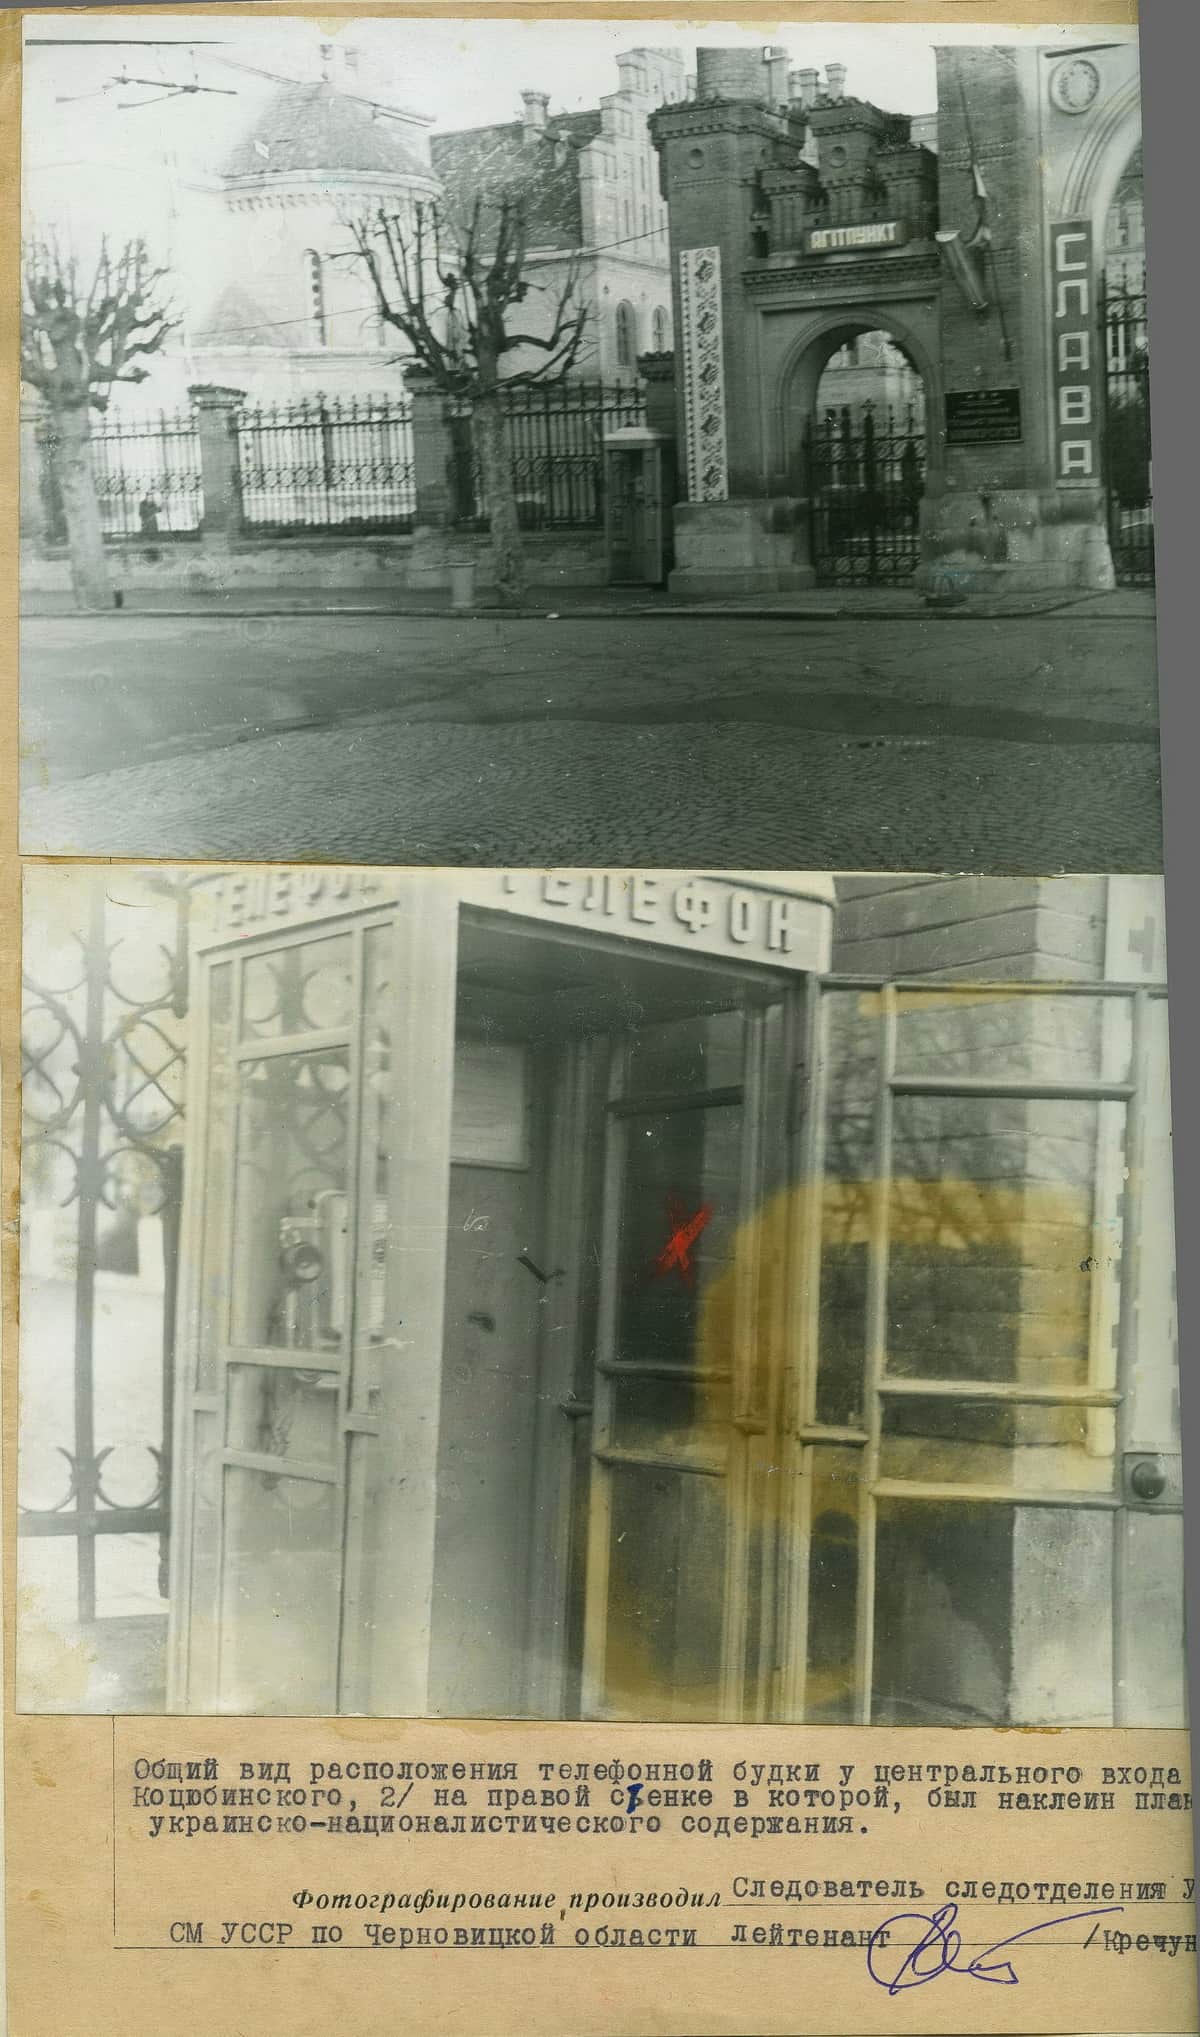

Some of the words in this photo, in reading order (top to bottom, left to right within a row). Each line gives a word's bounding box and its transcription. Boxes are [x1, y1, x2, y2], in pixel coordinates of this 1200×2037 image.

[1055, 232, 1093, 475] СЛАВА
[134, 1758, 219, 1785] Общий
[240, 1763, 291, 1785] вид
[310, 1761, 518, 1786] расположения
[538, 1759, 714, 1785] телефонной
[734, 1759, 821, 1787] будки
[839, 1765, 855, 1788] у
[875, 1764, 1083, 1788] центрального
[1101, 1766, 1182, 1789] входа
[133, 1784, 357, 1812] Коцюбинского,
[380, 1785, 414, 1809] 2/
[434, 1788, 467, 1807] на
[488, 1785, 591, 1812] правой
[734, 1789, 749, 1808] в
[768, 1785, 902, 1813] которой,
[928, 1786, 977, 1809] был
[998, 1792, 1115, 1810] наклеин
[148, 1814, 661, 1838] украинско-националистического
[681, 1815, 870, 1836] содержания.
[292, 1888, 557, 1912] Фотографирование
[569, 1888, 721, 1912] производил
[732, 1876, 925, 1901] Следователь
[945, 1881, 1167, 1904] следотделения
[170, 1922, 204, 1944] СМ
[221, 1922, 293, 1944] УССР
[312, 1925, 343, 1943] по
[364, 1921, 555, 1949] Черновицкой
[574, 1922, 698, 1947] области
